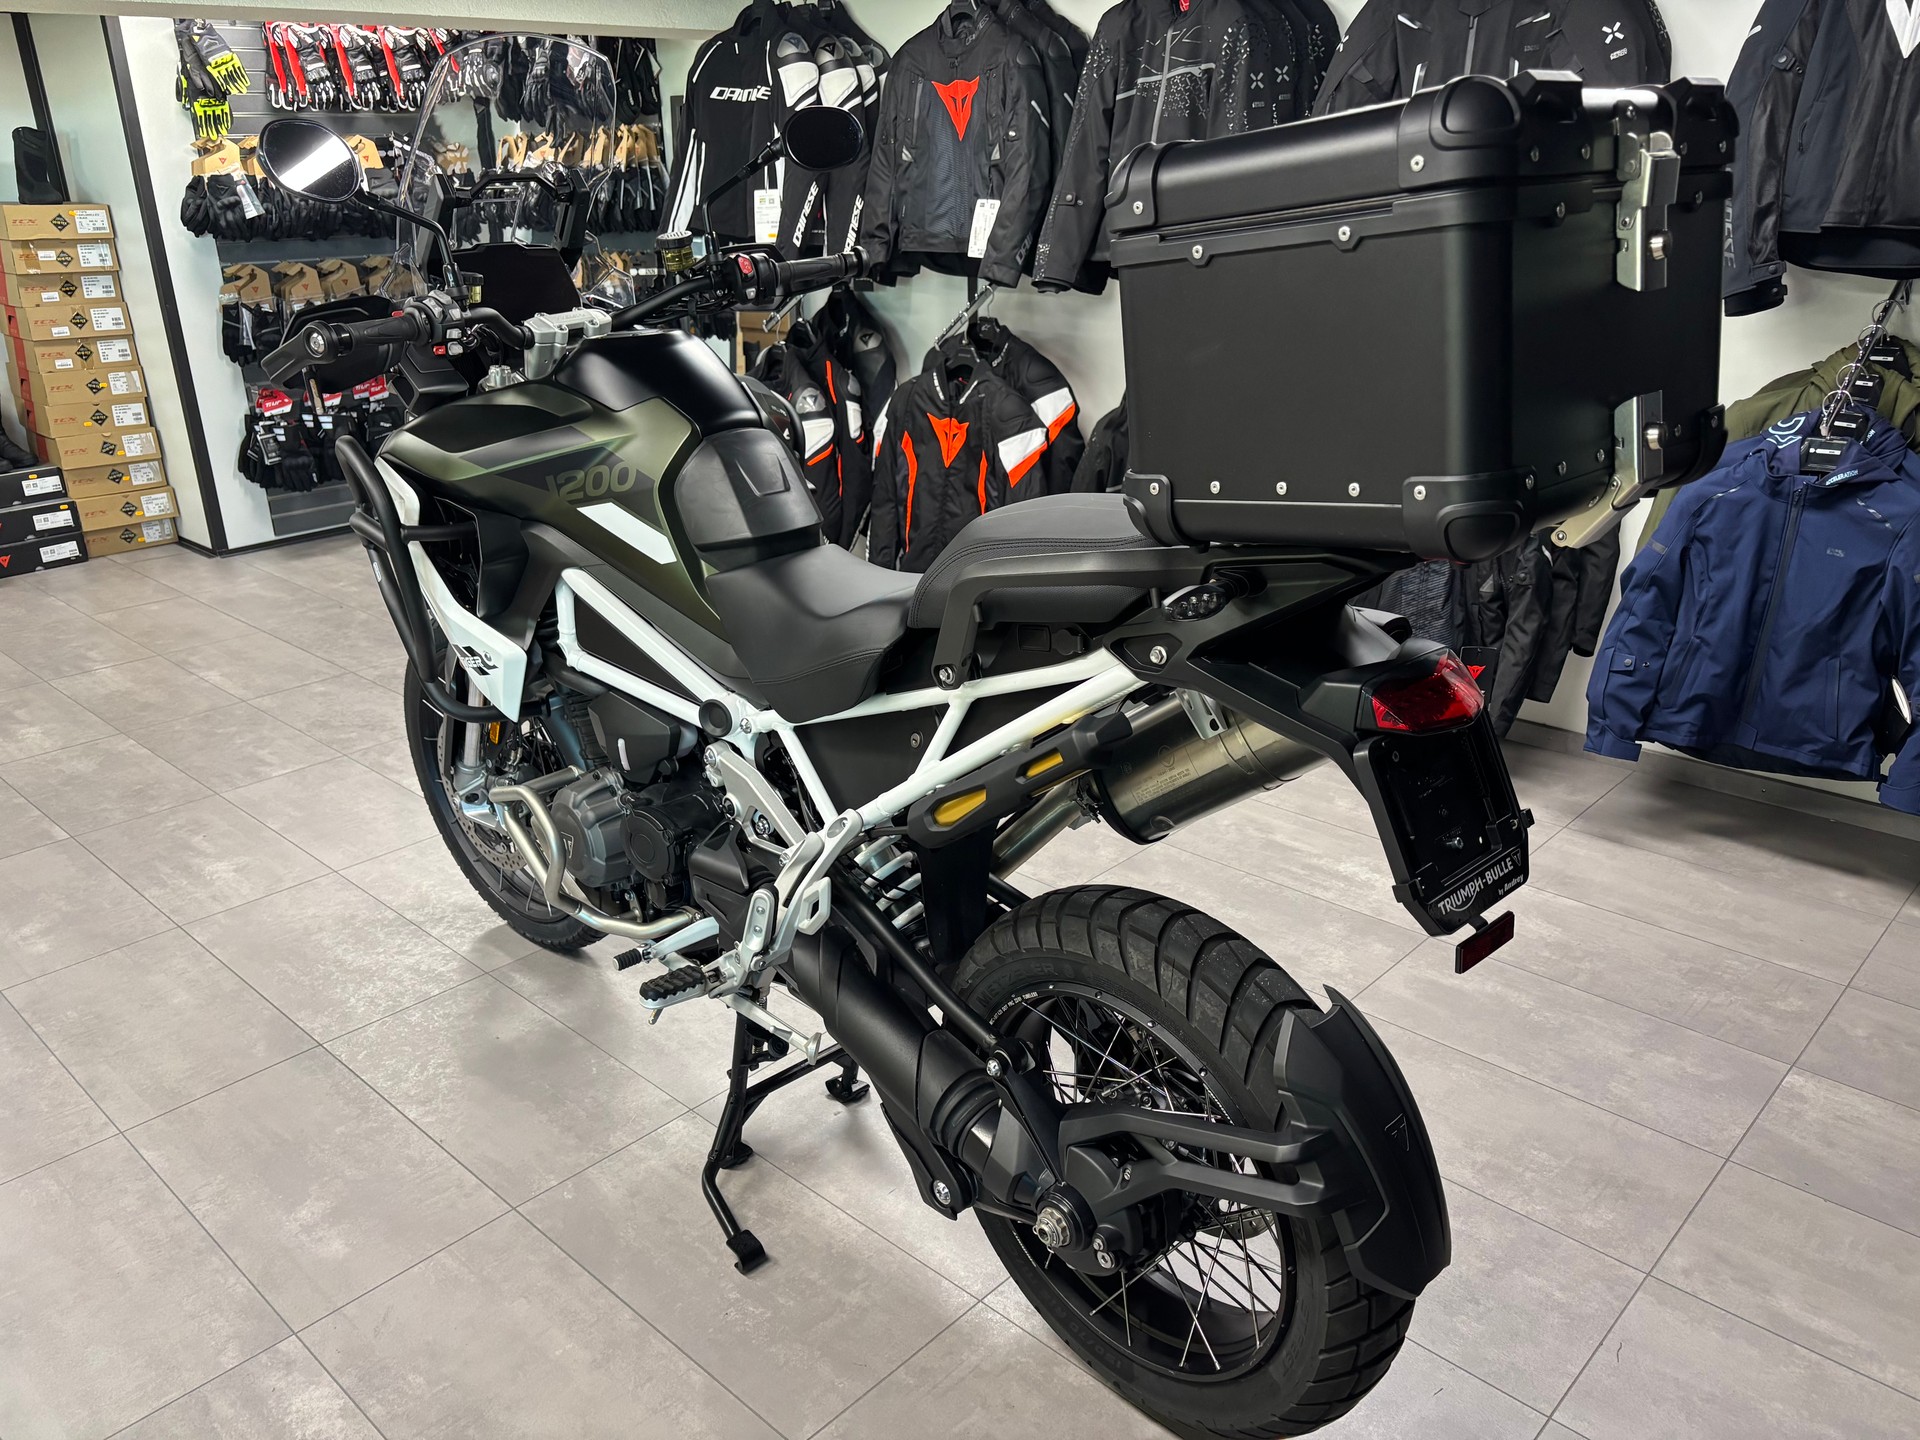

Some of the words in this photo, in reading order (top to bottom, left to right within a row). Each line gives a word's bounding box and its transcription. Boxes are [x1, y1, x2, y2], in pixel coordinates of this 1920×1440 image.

[709, 85, 772, 103] DAINE
[792, 181, 820, 248] DAINESE
[843, 194, 865, 254] AINESE
[545, 461, 637, 501] 1200
[1437, 857, 1514, 916] TRIUMPH-BULLE
